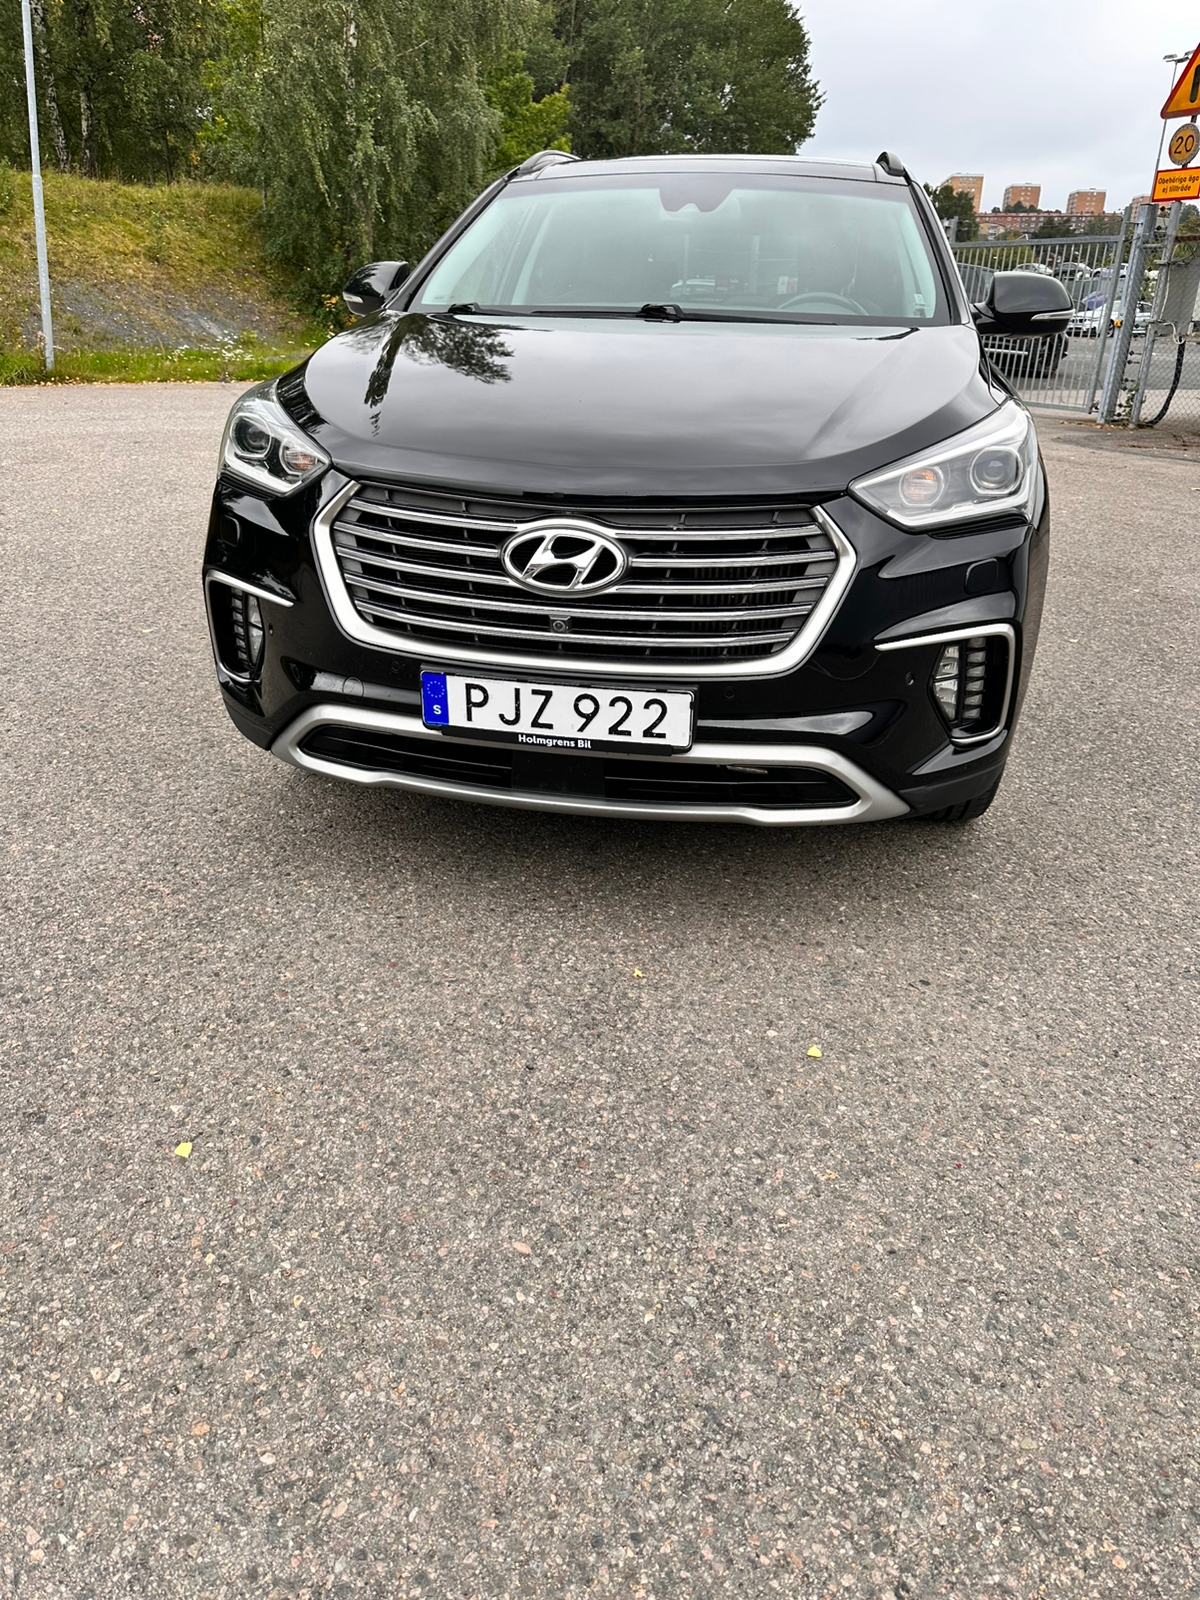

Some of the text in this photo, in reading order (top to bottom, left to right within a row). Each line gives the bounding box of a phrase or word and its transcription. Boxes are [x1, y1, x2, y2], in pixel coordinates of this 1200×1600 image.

[1174, 134, 1195, 154] 20
[1158, 175, 1187, 184] Obehöriga
[1169, 184, 1191, 192] tillträde
[433, 704, 442, 715] S
[464, 682, 668, 739] PJZ 922
[518, 734, 592, 749] Holmgrens Bil
